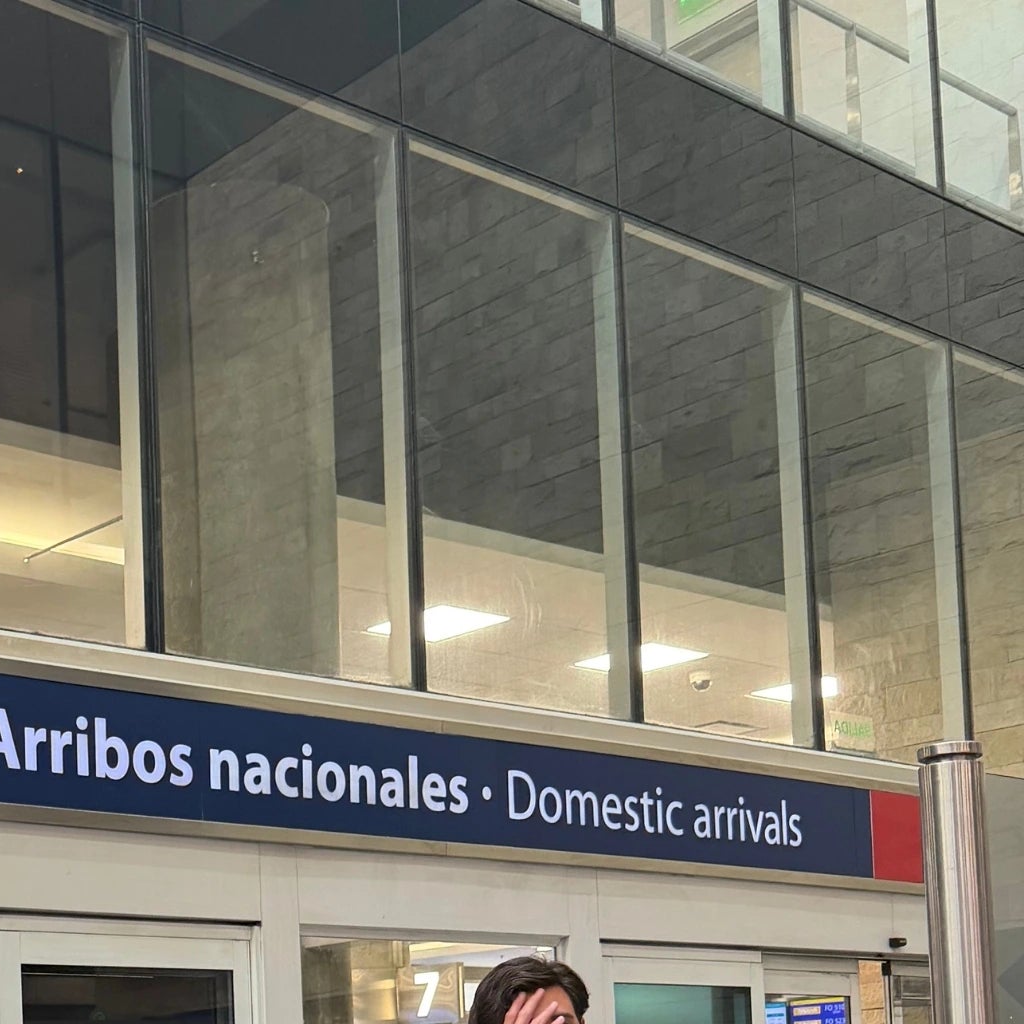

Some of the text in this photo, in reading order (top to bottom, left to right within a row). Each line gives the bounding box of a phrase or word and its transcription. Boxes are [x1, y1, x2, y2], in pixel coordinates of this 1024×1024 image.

[209, 743, 469, 814] nacionales
[507, 769, 684, 836] Domestic
[693, 796, 802, 848] arrivals
[413, 971, 440, 1018] 7
